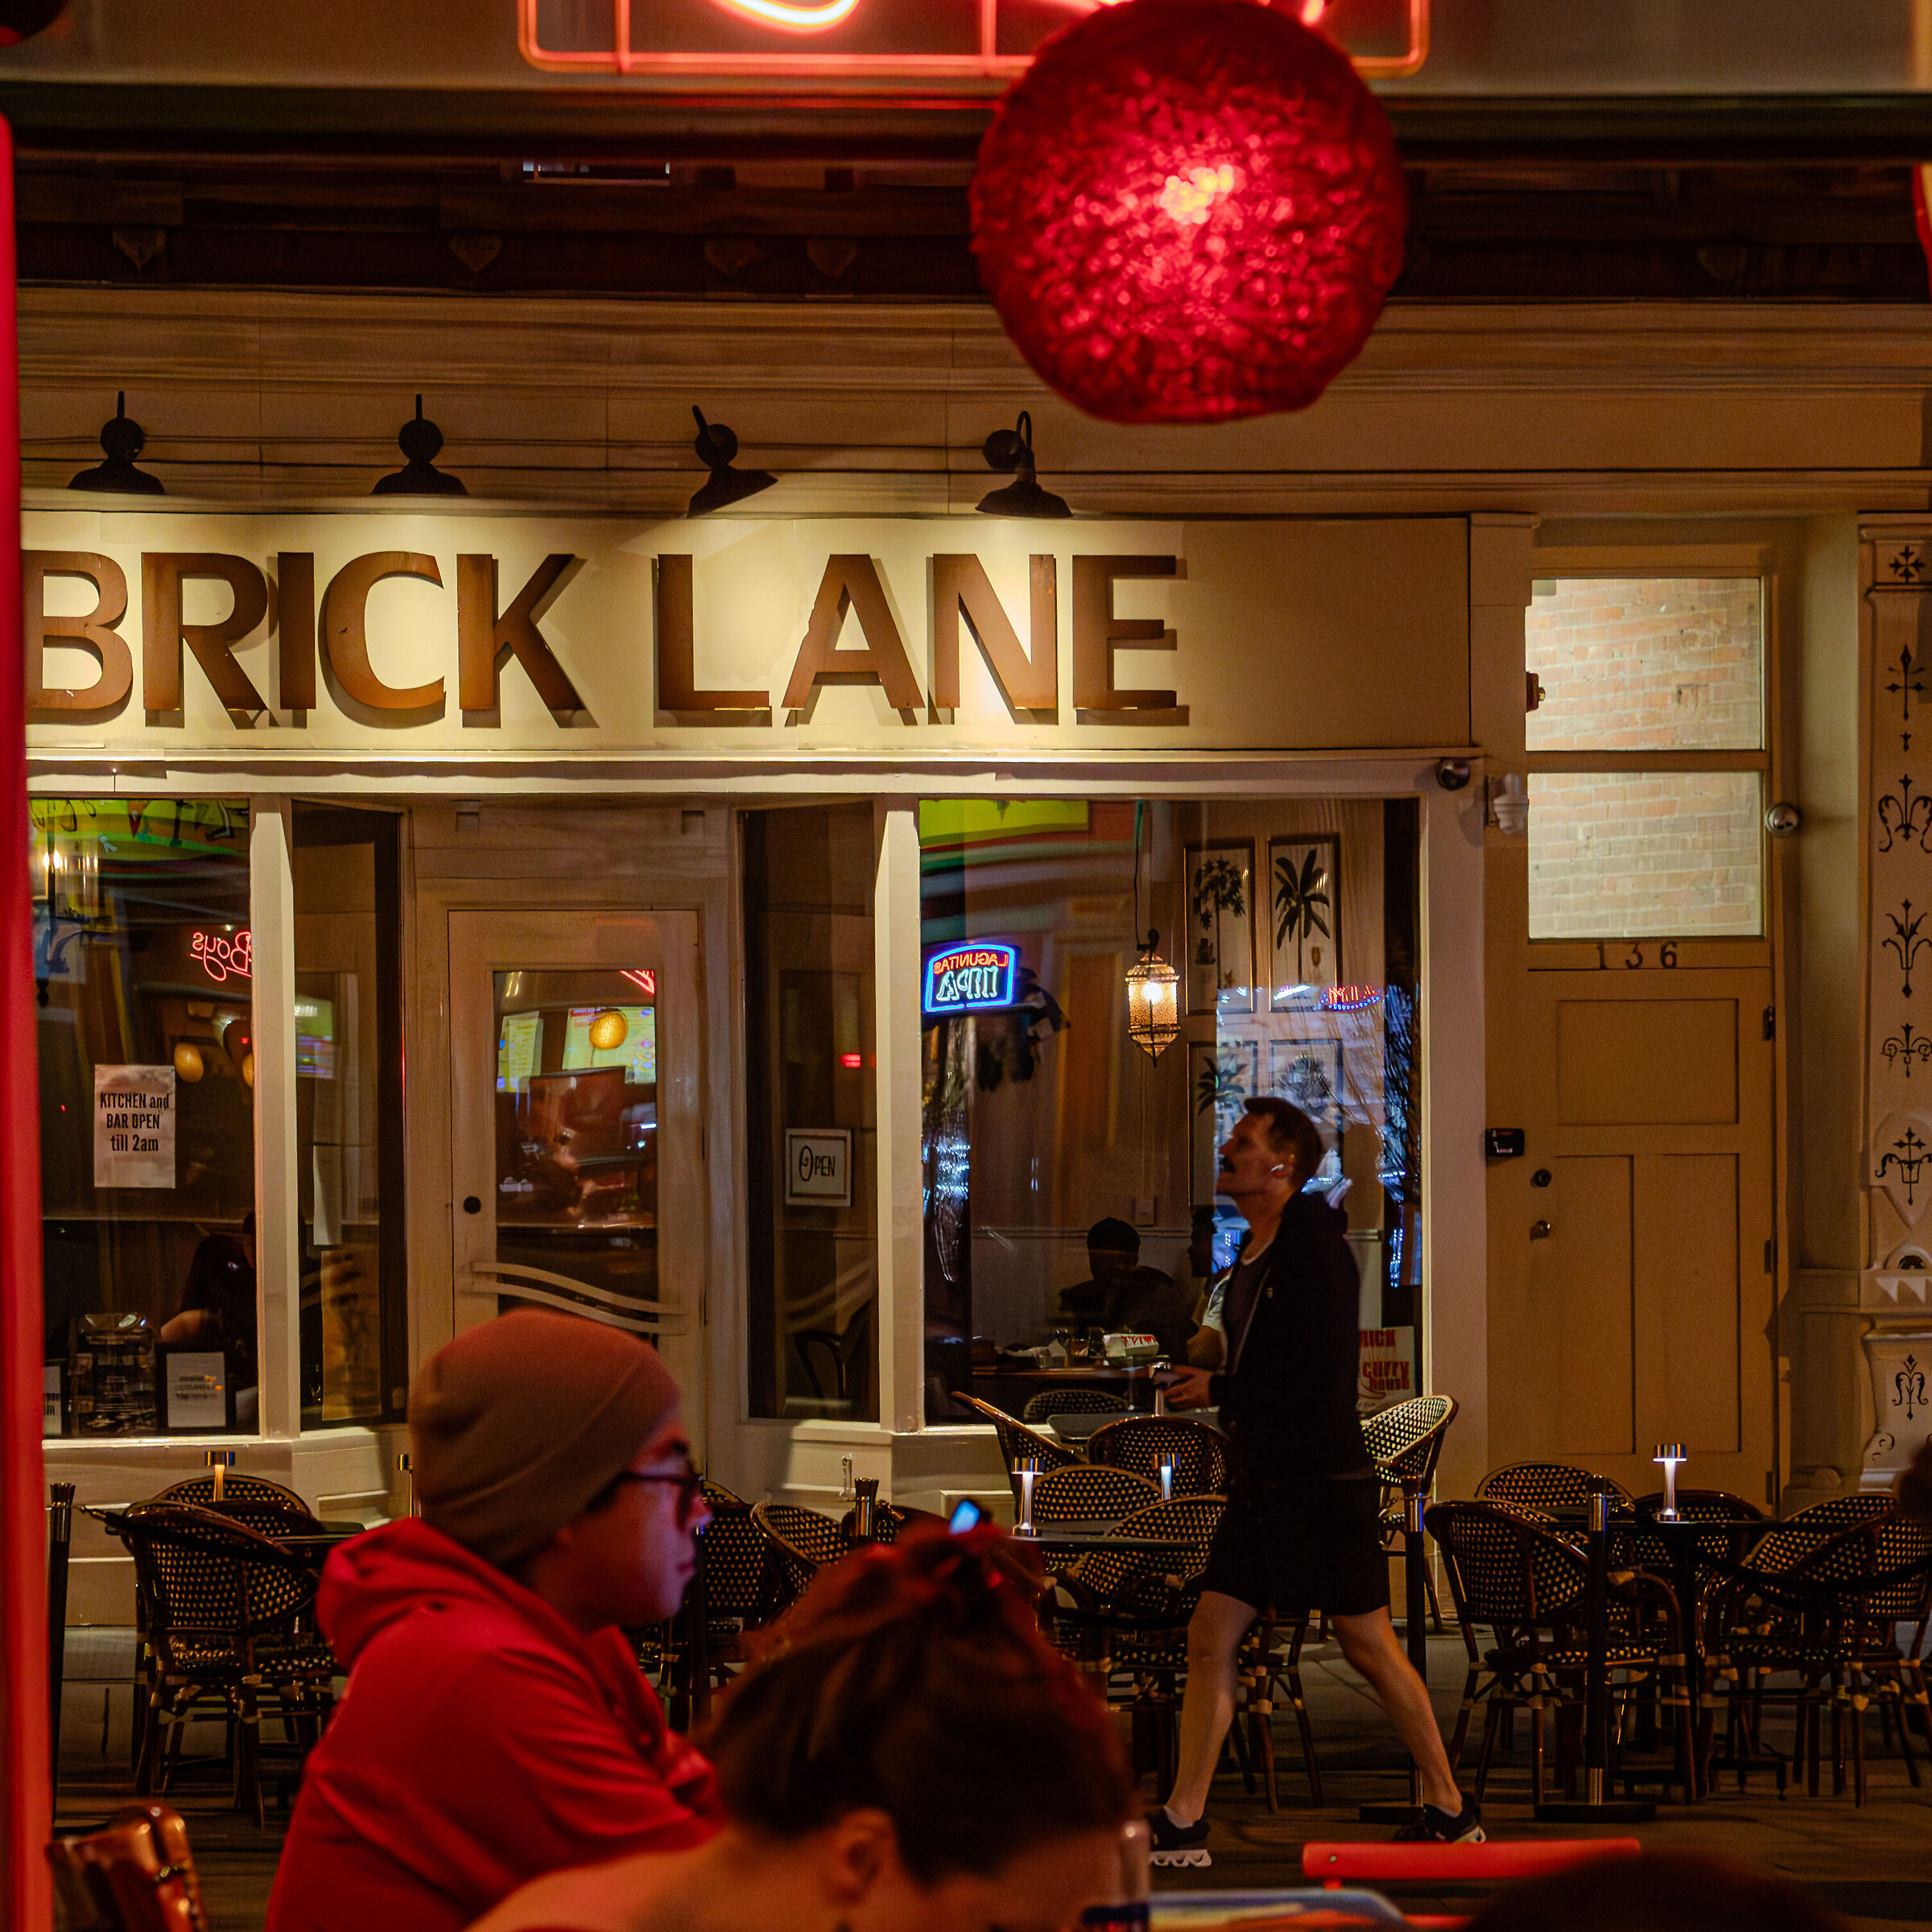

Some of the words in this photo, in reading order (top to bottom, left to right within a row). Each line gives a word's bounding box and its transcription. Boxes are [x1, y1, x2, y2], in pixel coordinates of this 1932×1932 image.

[23, 551, 586, 712] BRICK
[657, 553, 1178, 710] LANE
[1596, 940, 1678, 970] 136
[100, 1092, 147, 1109] KITCHEN
[149, 1092, 170, 1109] and
[106, 1113, 129, 1129] BAR
[132, 1114, 160, 1129] OPEN
[110, 1133, 129, 1152] till
[132, 1133, 159, 1152] 2am
[799, 1145, 836, 1182] OPEN
